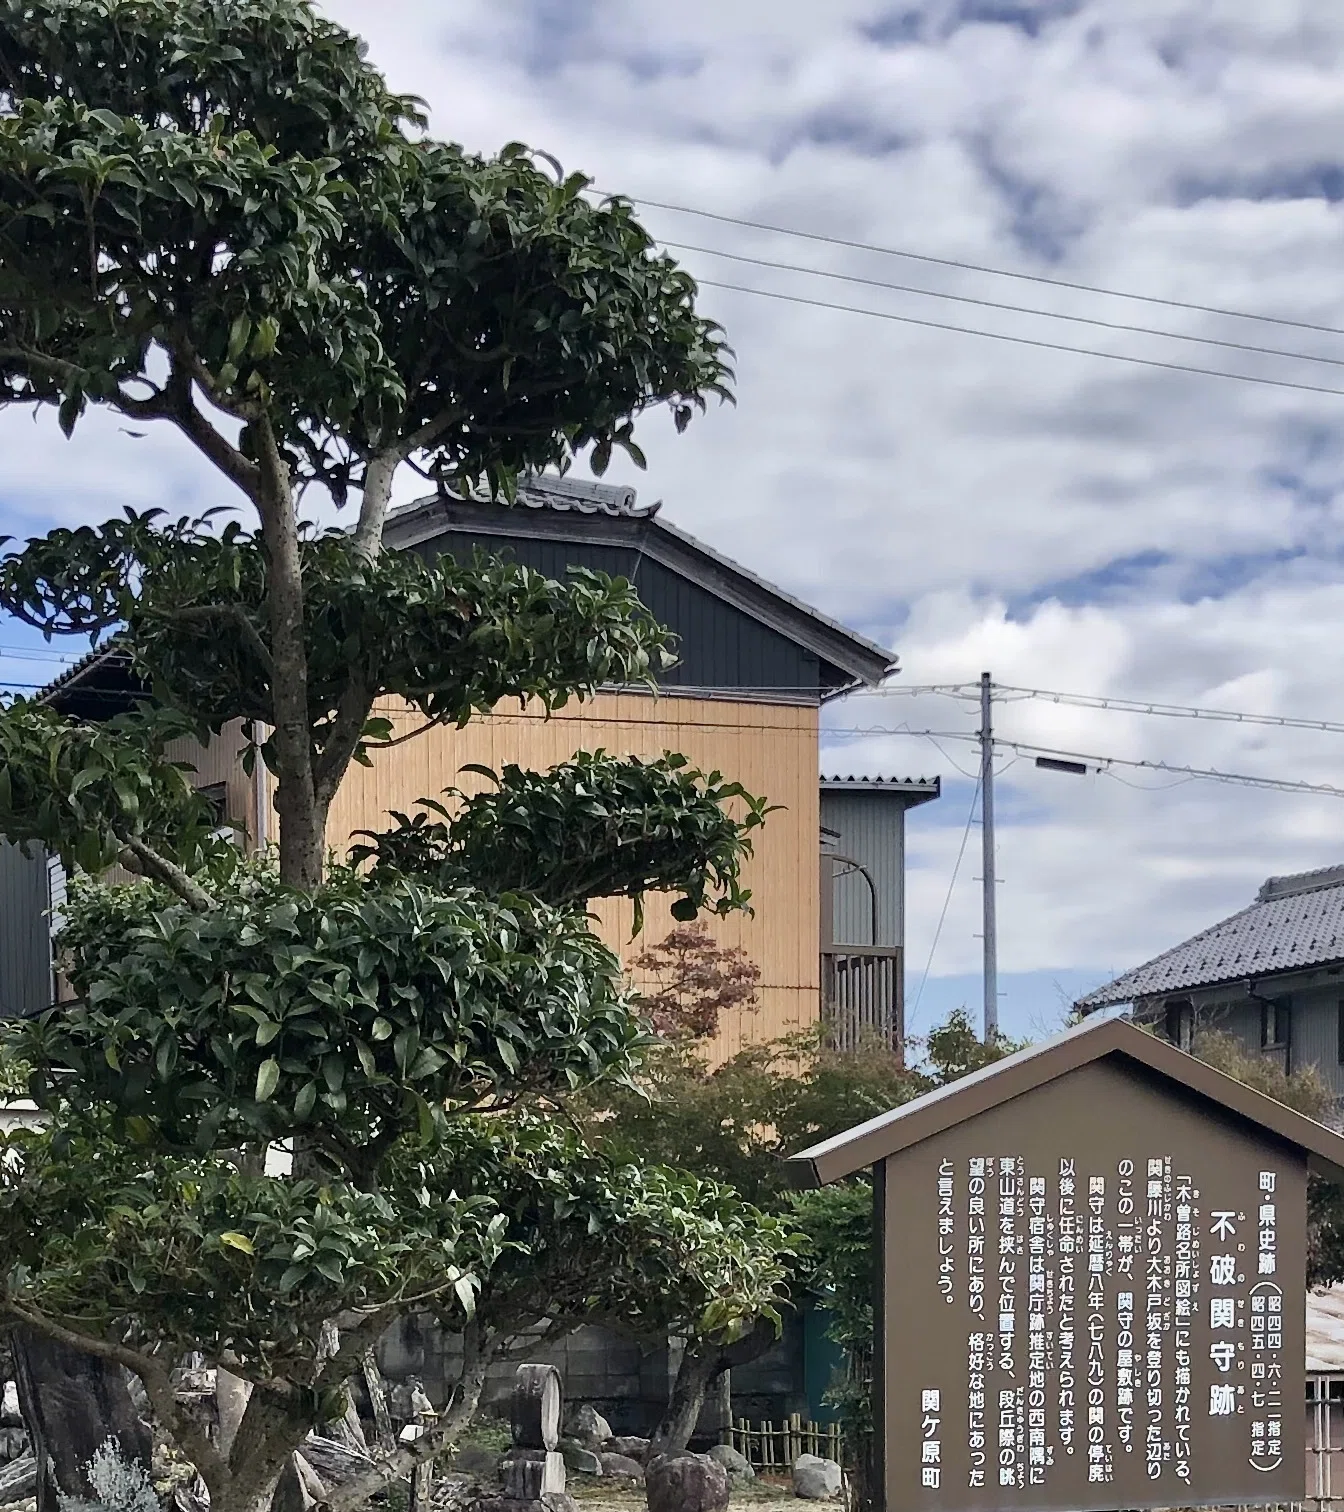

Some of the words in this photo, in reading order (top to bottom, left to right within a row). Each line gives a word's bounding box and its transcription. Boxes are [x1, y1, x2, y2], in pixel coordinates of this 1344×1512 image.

[937, 1157, 954, 1304] と言えましょう。
[1258, 1171, 1276, 1275] 町・県史跡
[1058, 1158, 1076, 1455] 以後に任命されたと考えられます。
[1209, 1210, 1236, 1416] 不破関守跡
[921, 1389, 941, 1489] 関ケ原町
